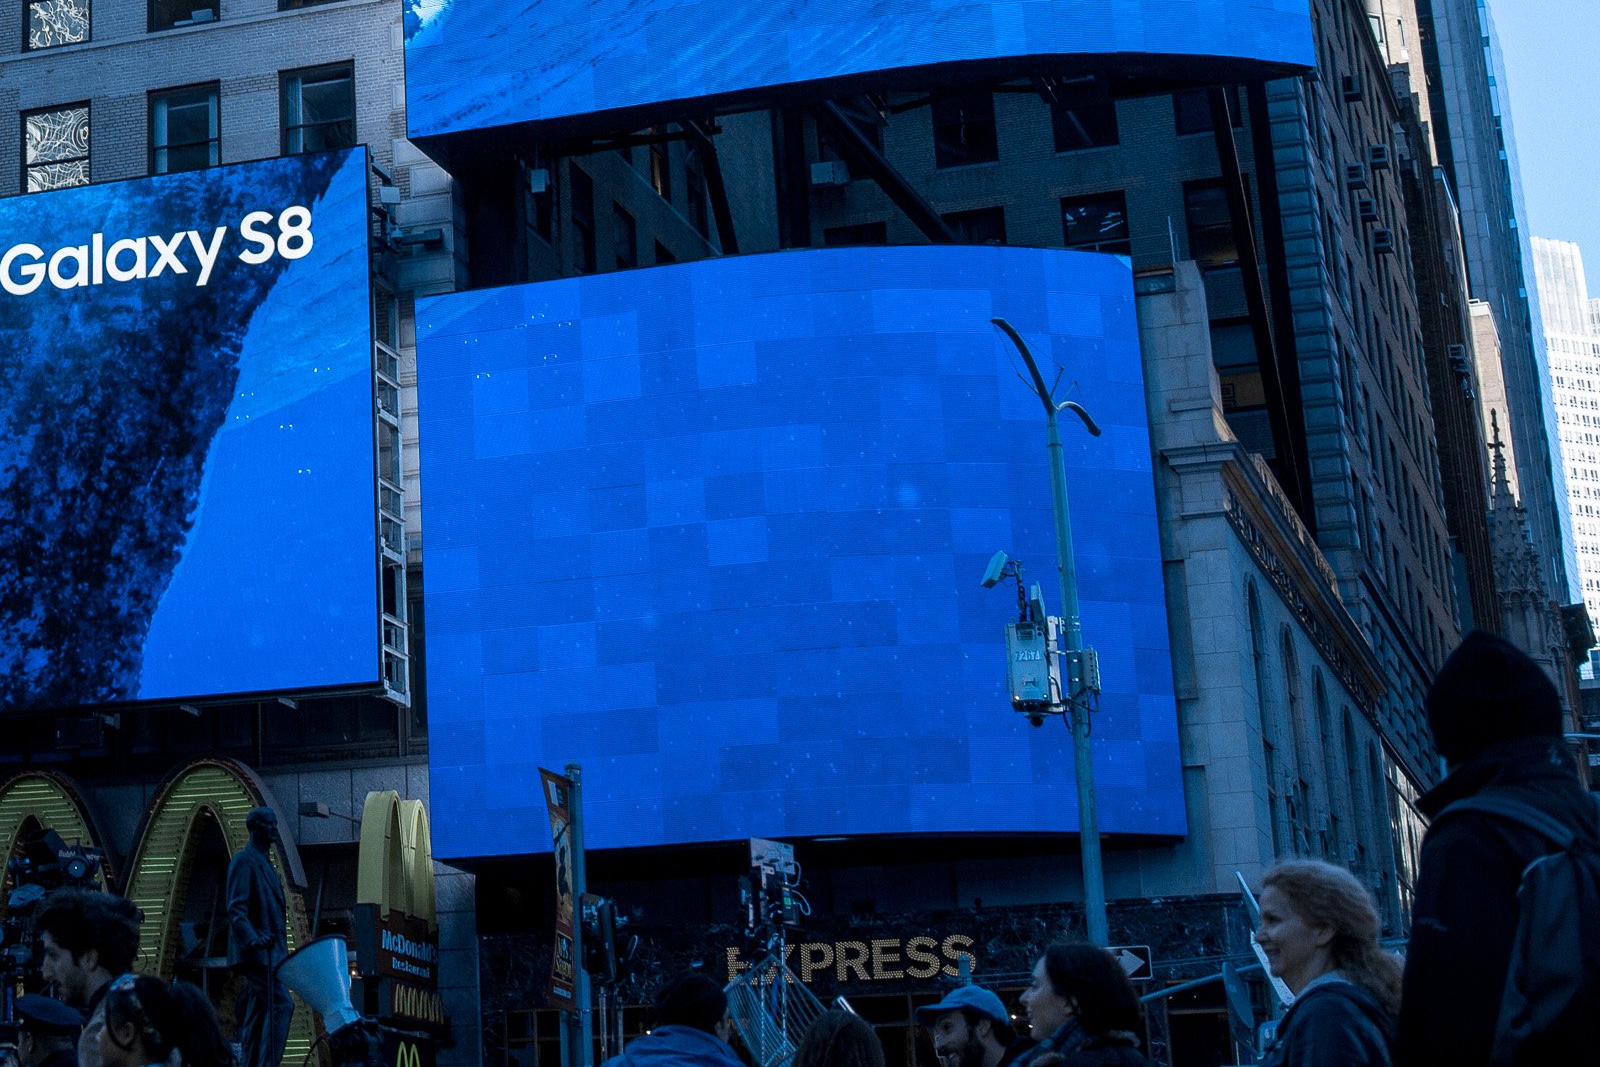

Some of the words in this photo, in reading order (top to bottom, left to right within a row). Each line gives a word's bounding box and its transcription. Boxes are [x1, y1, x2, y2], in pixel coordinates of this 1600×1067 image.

[238, 205, 314, 265] S8
[381, 928, 438, 965] McDonald's
[392, 956, 431, 979] Restaurant
